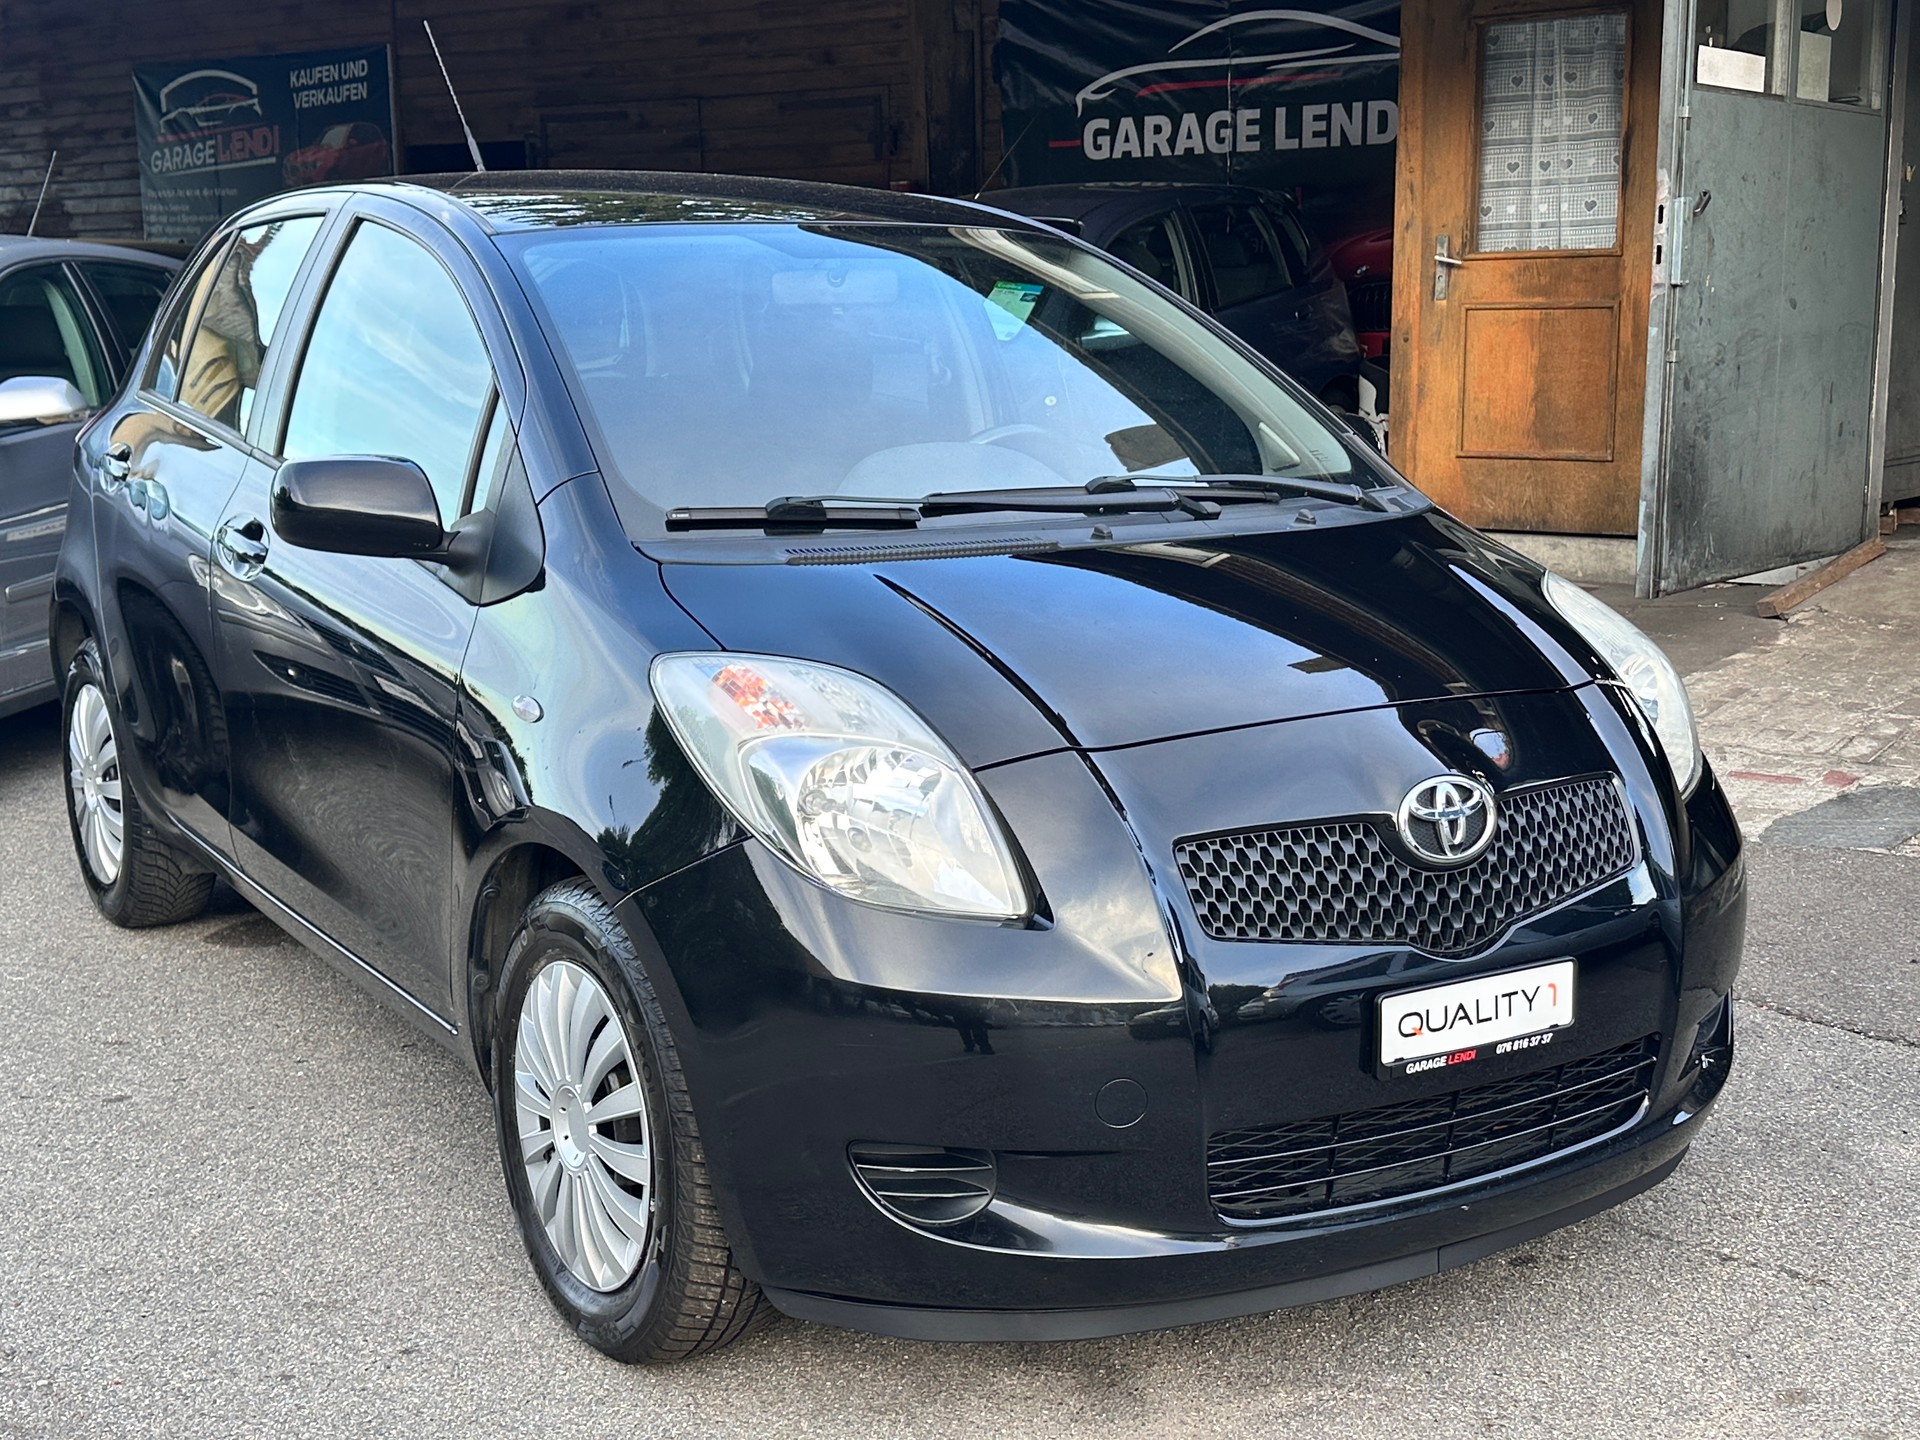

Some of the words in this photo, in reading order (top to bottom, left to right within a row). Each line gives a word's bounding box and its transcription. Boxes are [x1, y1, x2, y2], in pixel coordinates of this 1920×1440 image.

[290, 63, 339, 88] KAUFEN
[341, 59, 368, 79] UND
[293, 81, 367, 109] VERKAUFEN
[1083, 108, 1261, 160] GARAGE
[151, 139, 215, 173] GARAGE
[217, 125, 279, 161] LENDI
[1398, 986, 1540, 1038] QUALITY
[1495, 1041, 1512, 1054] 076
[1529, 1035, 1541, 1047] 37
[1541, 1033, 1553, 1044] 37
[1405, 1055, 1448, 1074] GARAGE
[1448, 1049, 1477, 1065] LENDI
